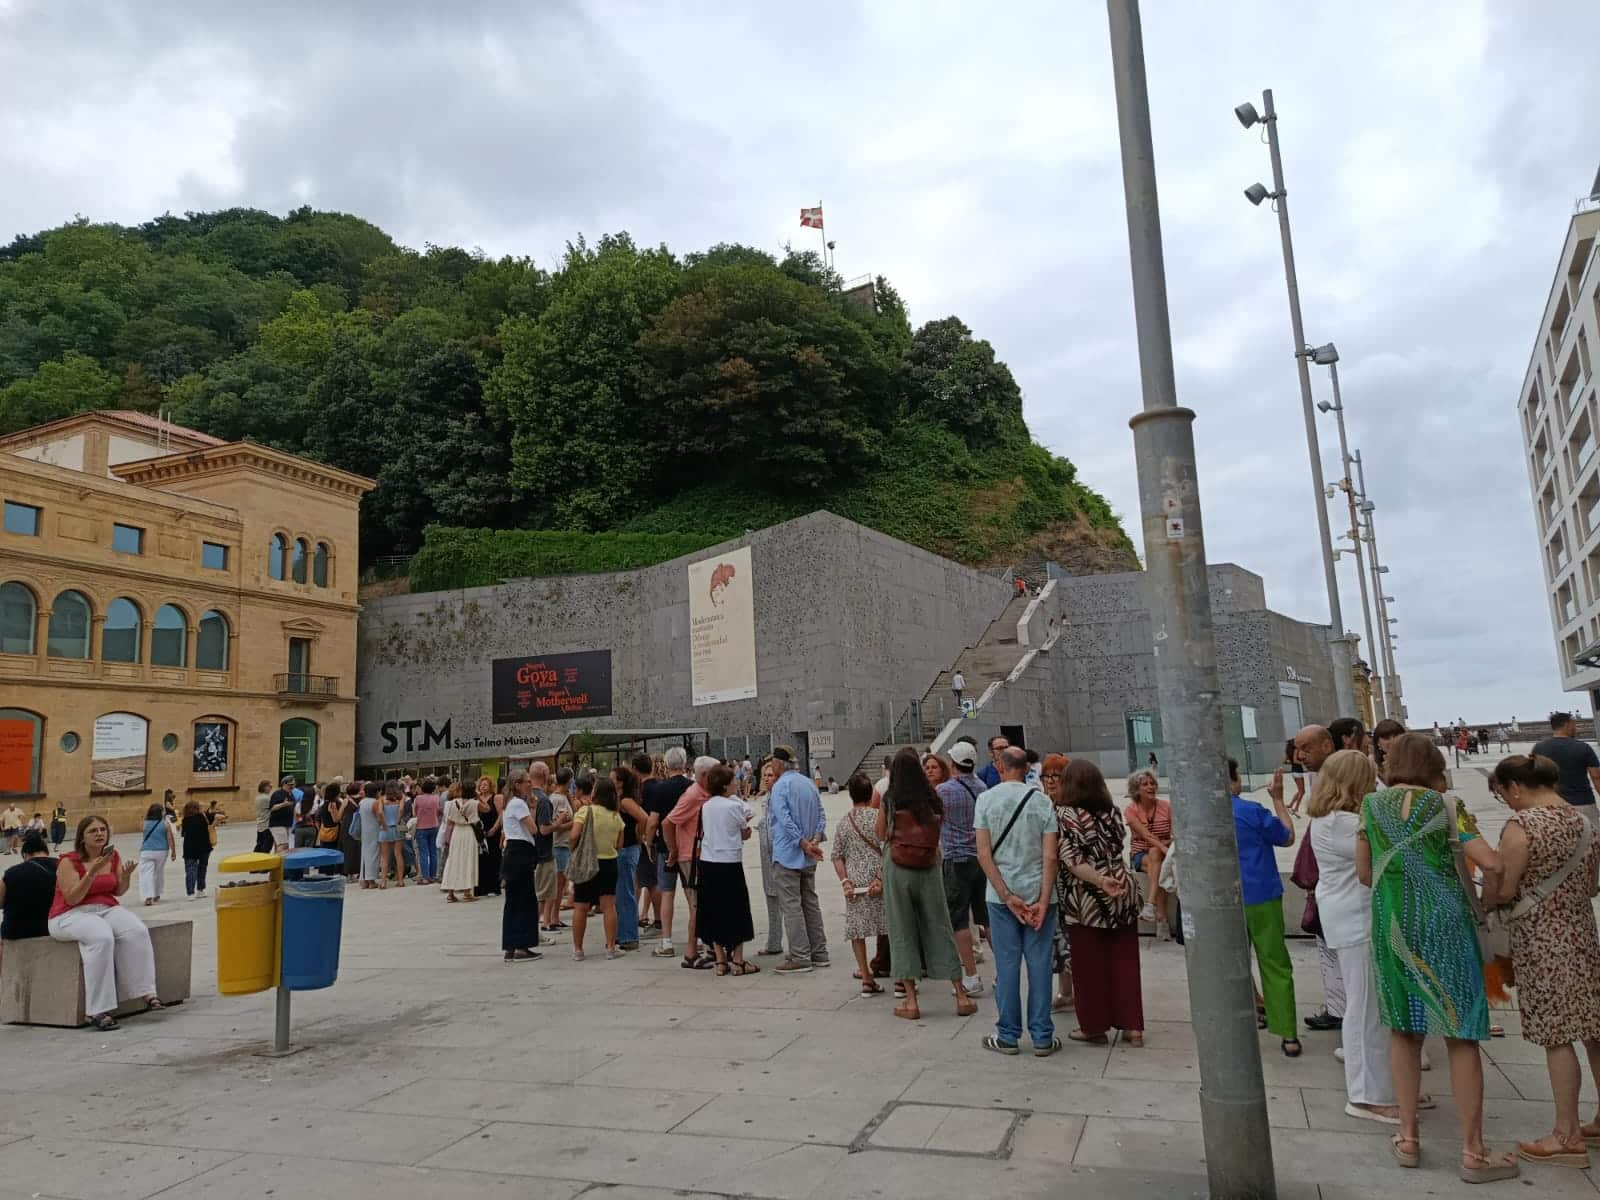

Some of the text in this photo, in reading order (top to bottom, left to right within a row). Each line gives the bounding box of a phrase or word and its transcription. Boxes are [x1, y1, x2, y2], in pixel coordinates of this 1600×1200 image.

[517, 667, 557, 685] Goya
[536, 692, 588, 708] Motherwell
[380, 718, 451, 754] STM
[454, 735, 541, 749] San Telmo Museoa
